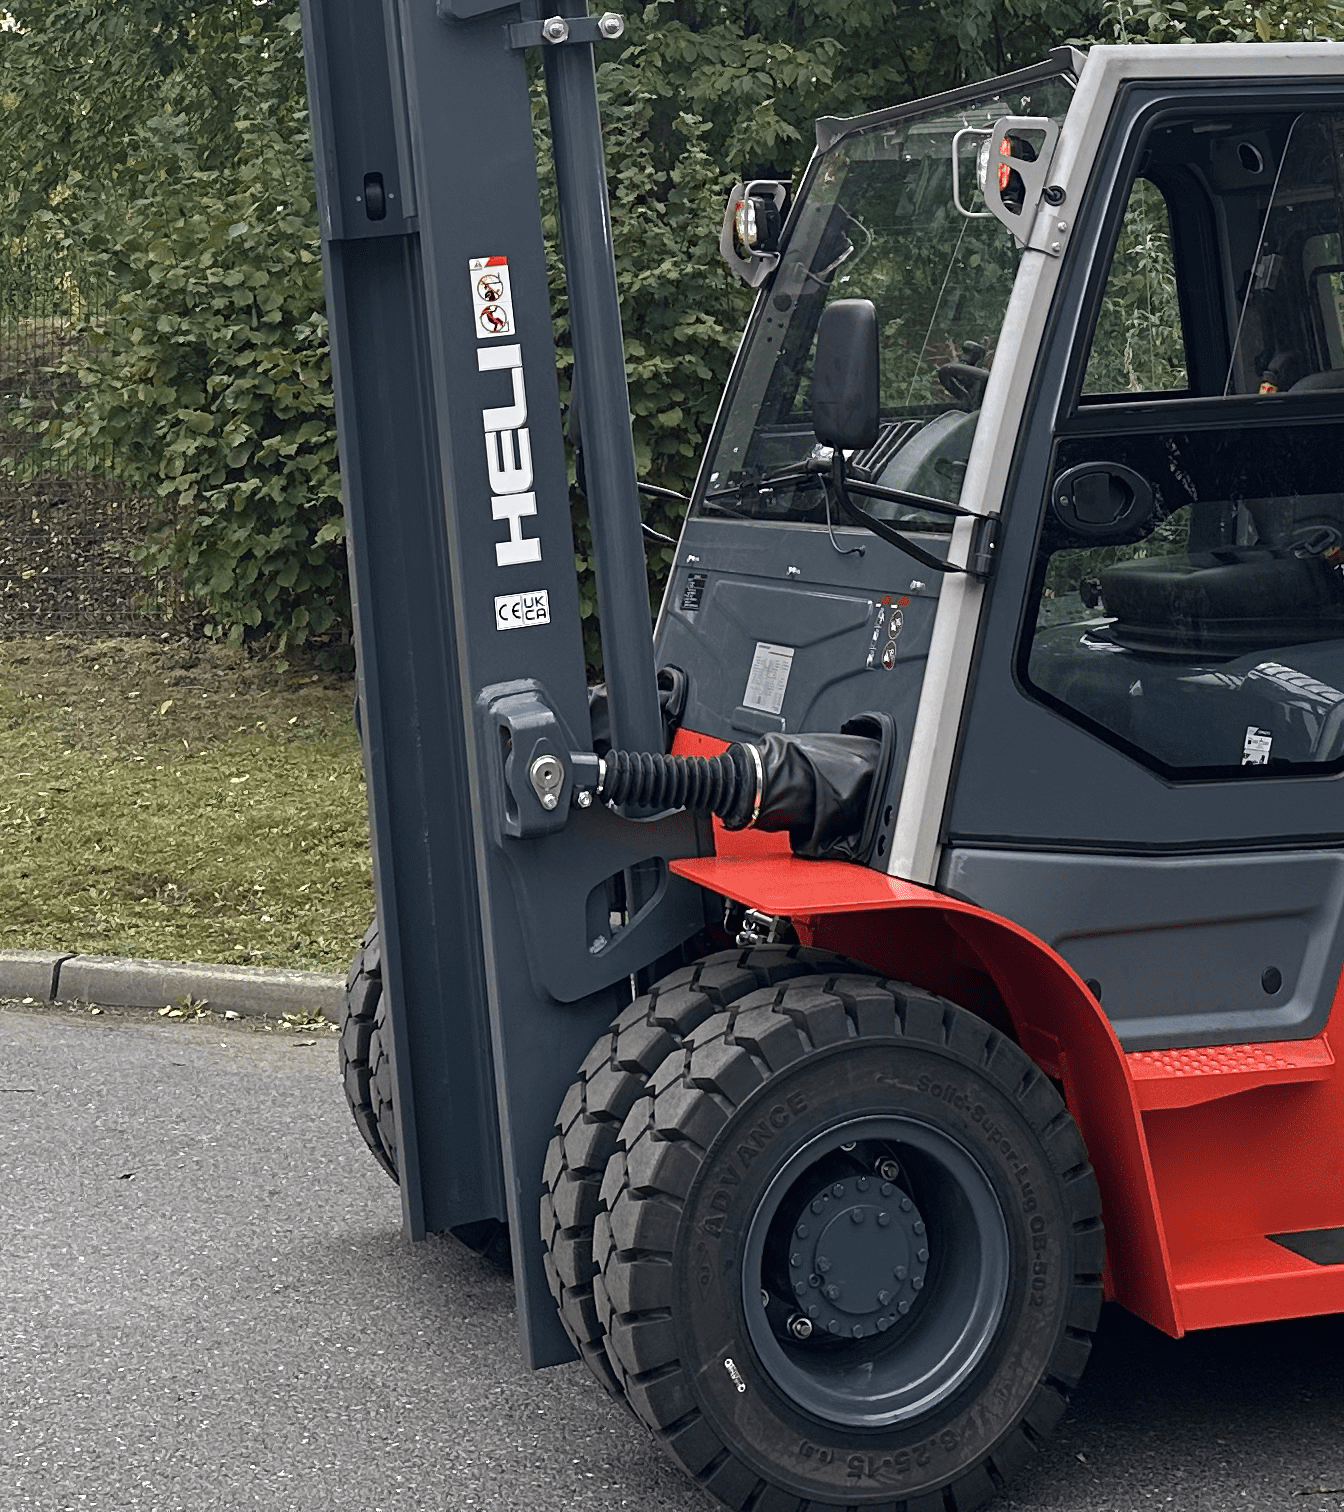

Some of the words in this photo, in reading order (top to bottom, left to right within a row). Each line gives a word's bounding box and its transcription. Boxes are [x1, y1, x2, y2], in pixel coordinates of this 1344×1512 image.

[477, 344, 542, 567] HELI
[499, 602, 521, 621] CE
[524, 596, 546, 608] UK
[525, 608, 547, 621] CA
[703, 1090, 808, 1239] ADVANCE
